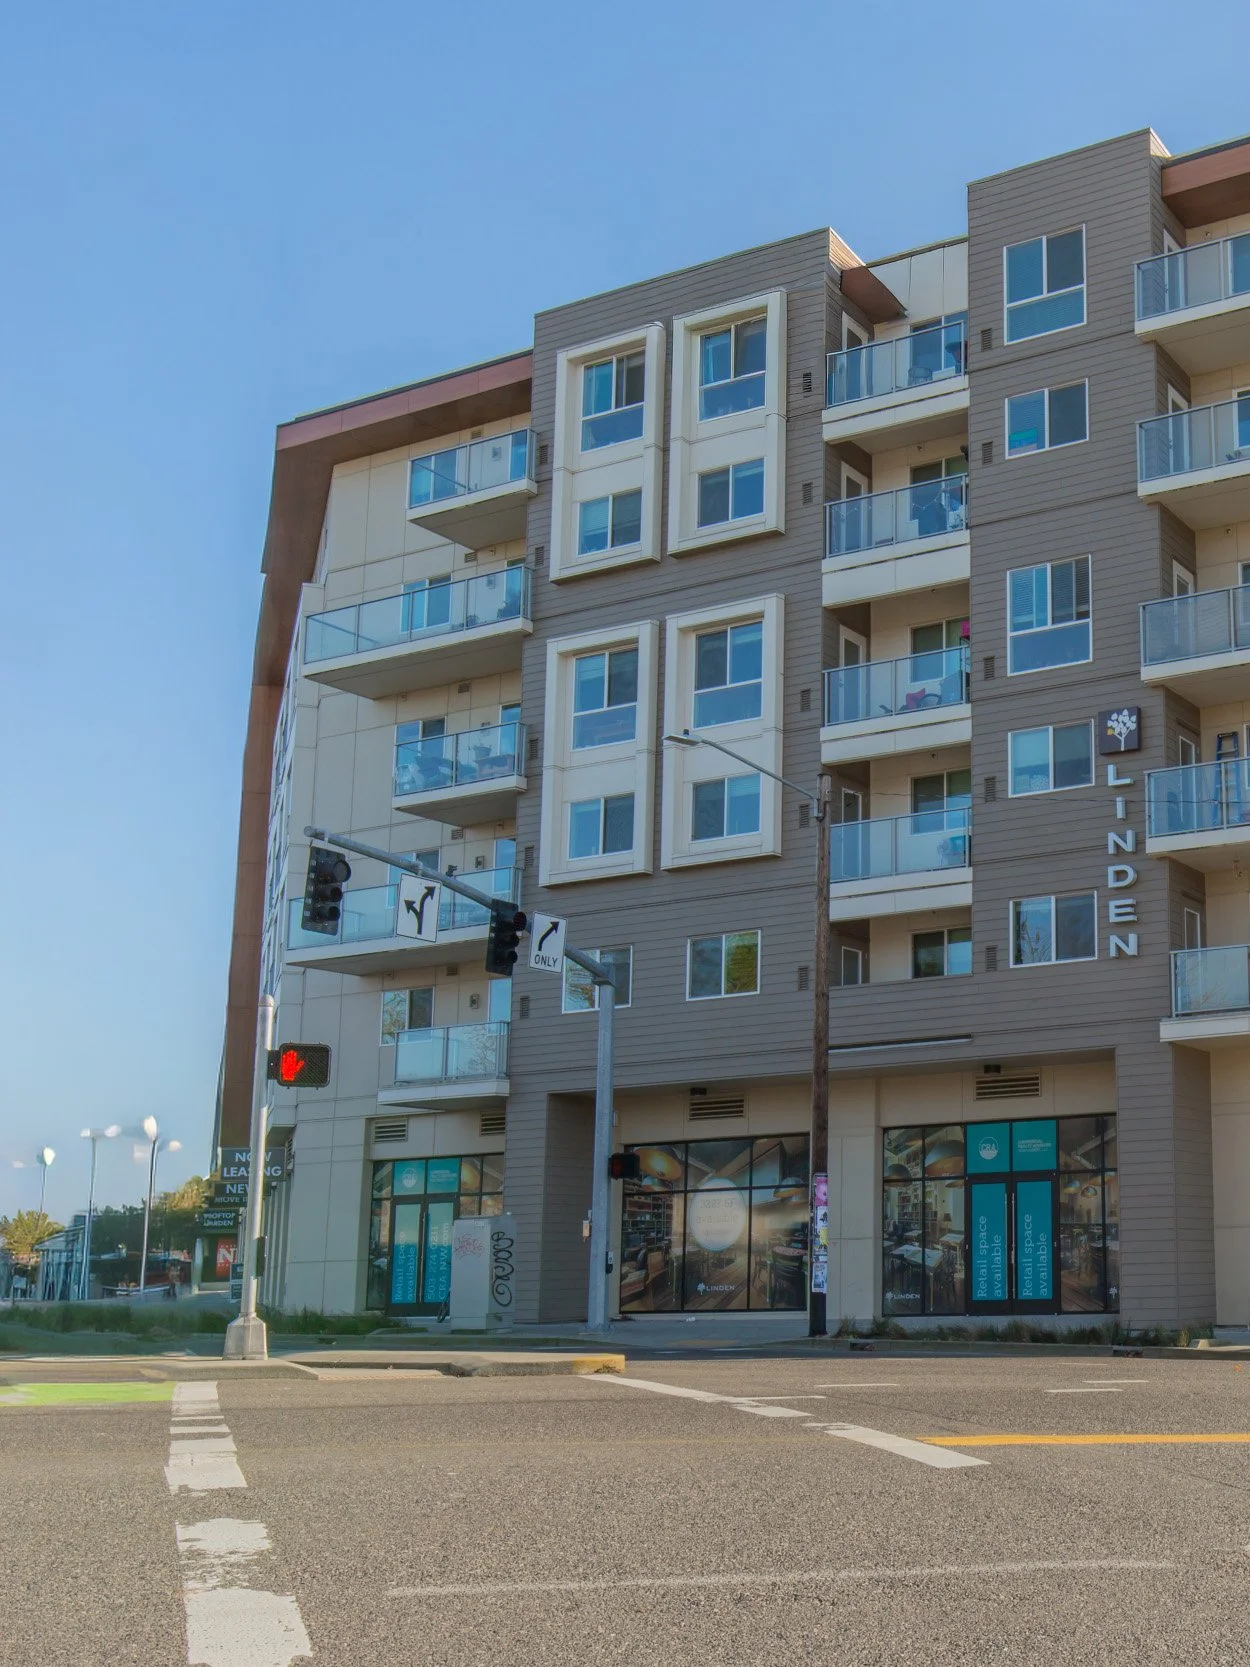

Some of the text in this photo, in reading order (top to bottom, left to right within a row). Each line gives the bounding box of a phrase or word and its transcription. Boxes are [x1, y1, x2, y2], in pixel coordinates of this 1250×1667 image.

[1107, 764, 1138, 957] LINDEN
[535, 954, 558, 968] ONLY
[223, 1166, 282, 1177] LEANG
[226, 1184, 250, 1194] NE
[407, 1246, 416, 1301] available
[977, 1216, 989, 1297] Retail space
[992, 1234, 1002, 1297] available
[1022, 1214, 1034, 1296] Retail space
[1037, 1232, 1048, 1296] available
[395, 1268, 403, 1300] Retail
[706, 1284, 735, 1292] LINDEN
